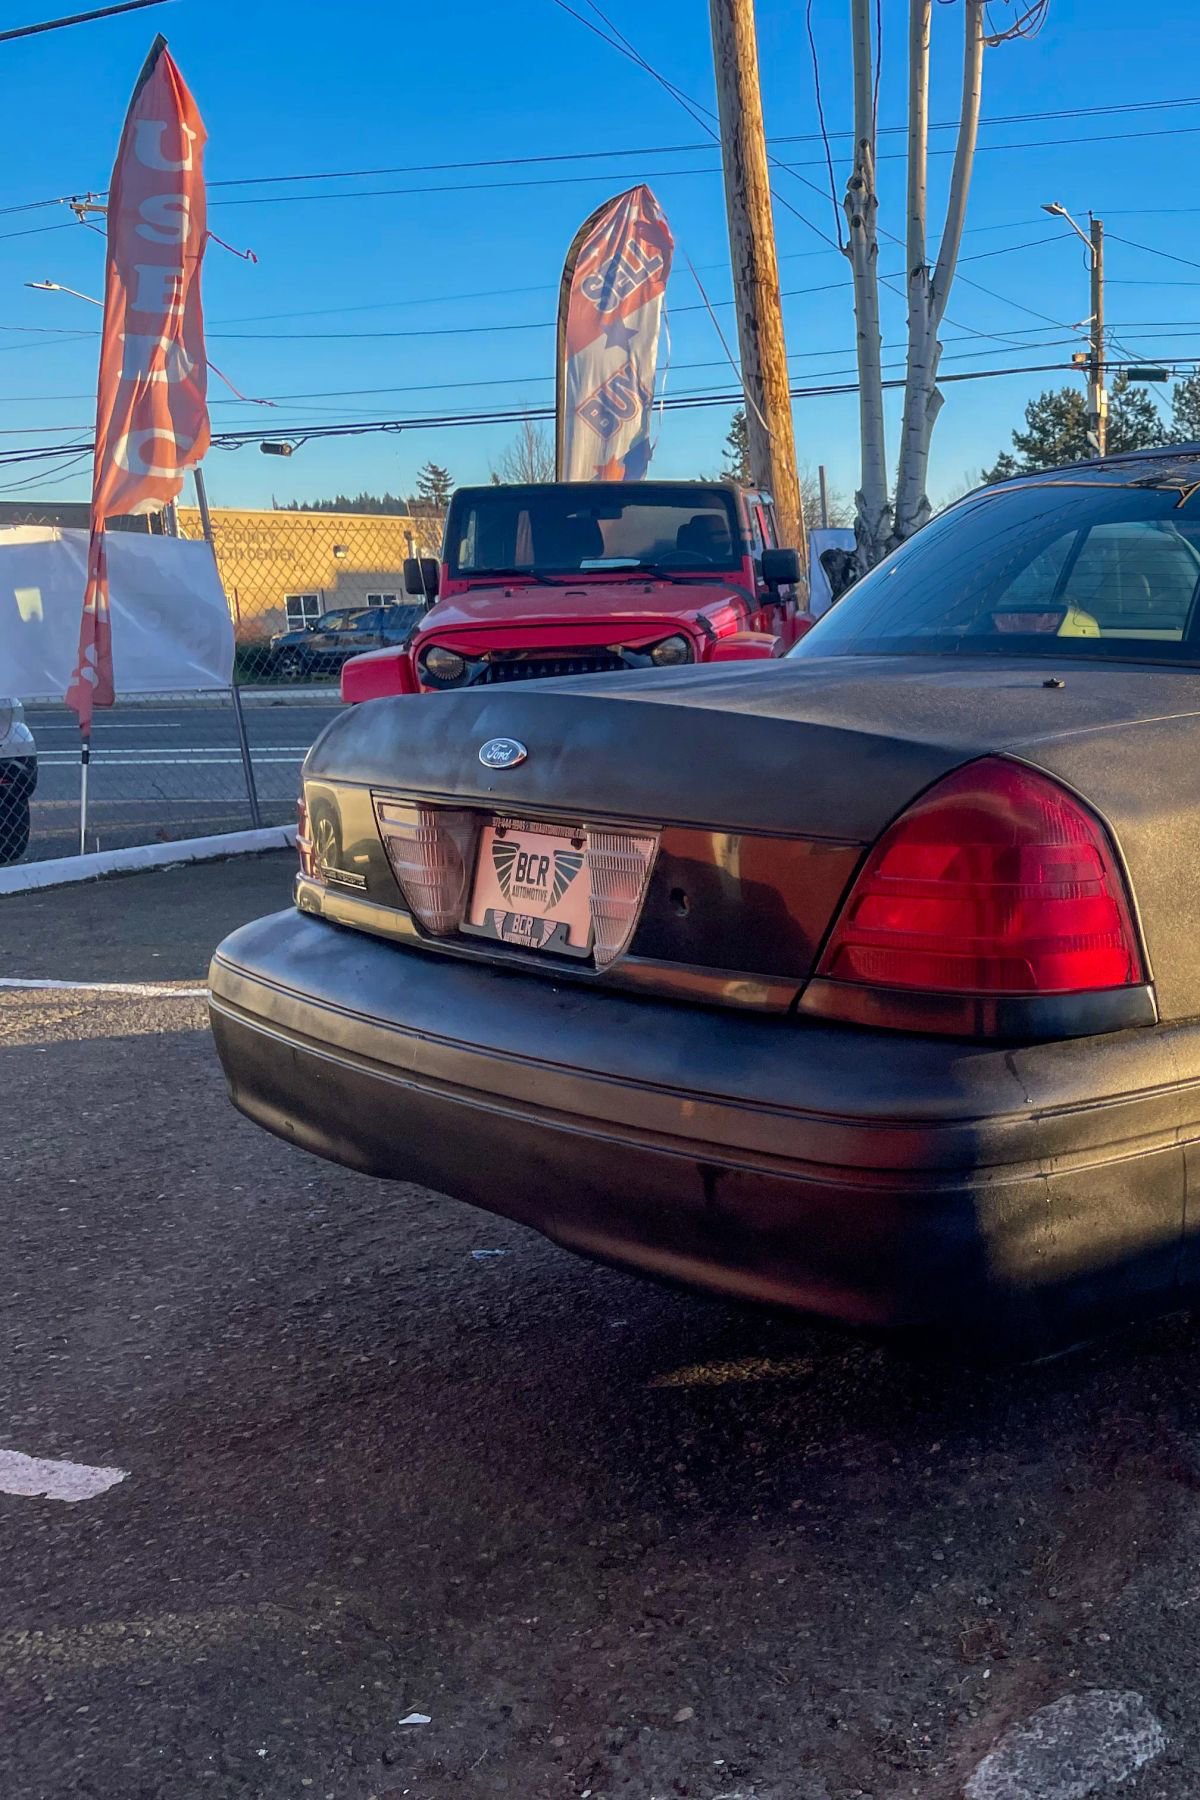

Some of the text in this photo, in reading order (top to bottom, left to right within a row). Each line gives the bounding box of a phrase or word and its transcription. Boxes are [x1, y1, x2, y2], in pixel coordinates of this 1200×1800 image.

[117, 119, 197, 383] USED
[580, 238, 664, 315] SELL
[486, 743, 513, 761] Ford
[515, 852, 550, 887] BCR
[511, 884, 548, 903] AUTOMOTIVE
[511, 914, 534, 936] BCR
